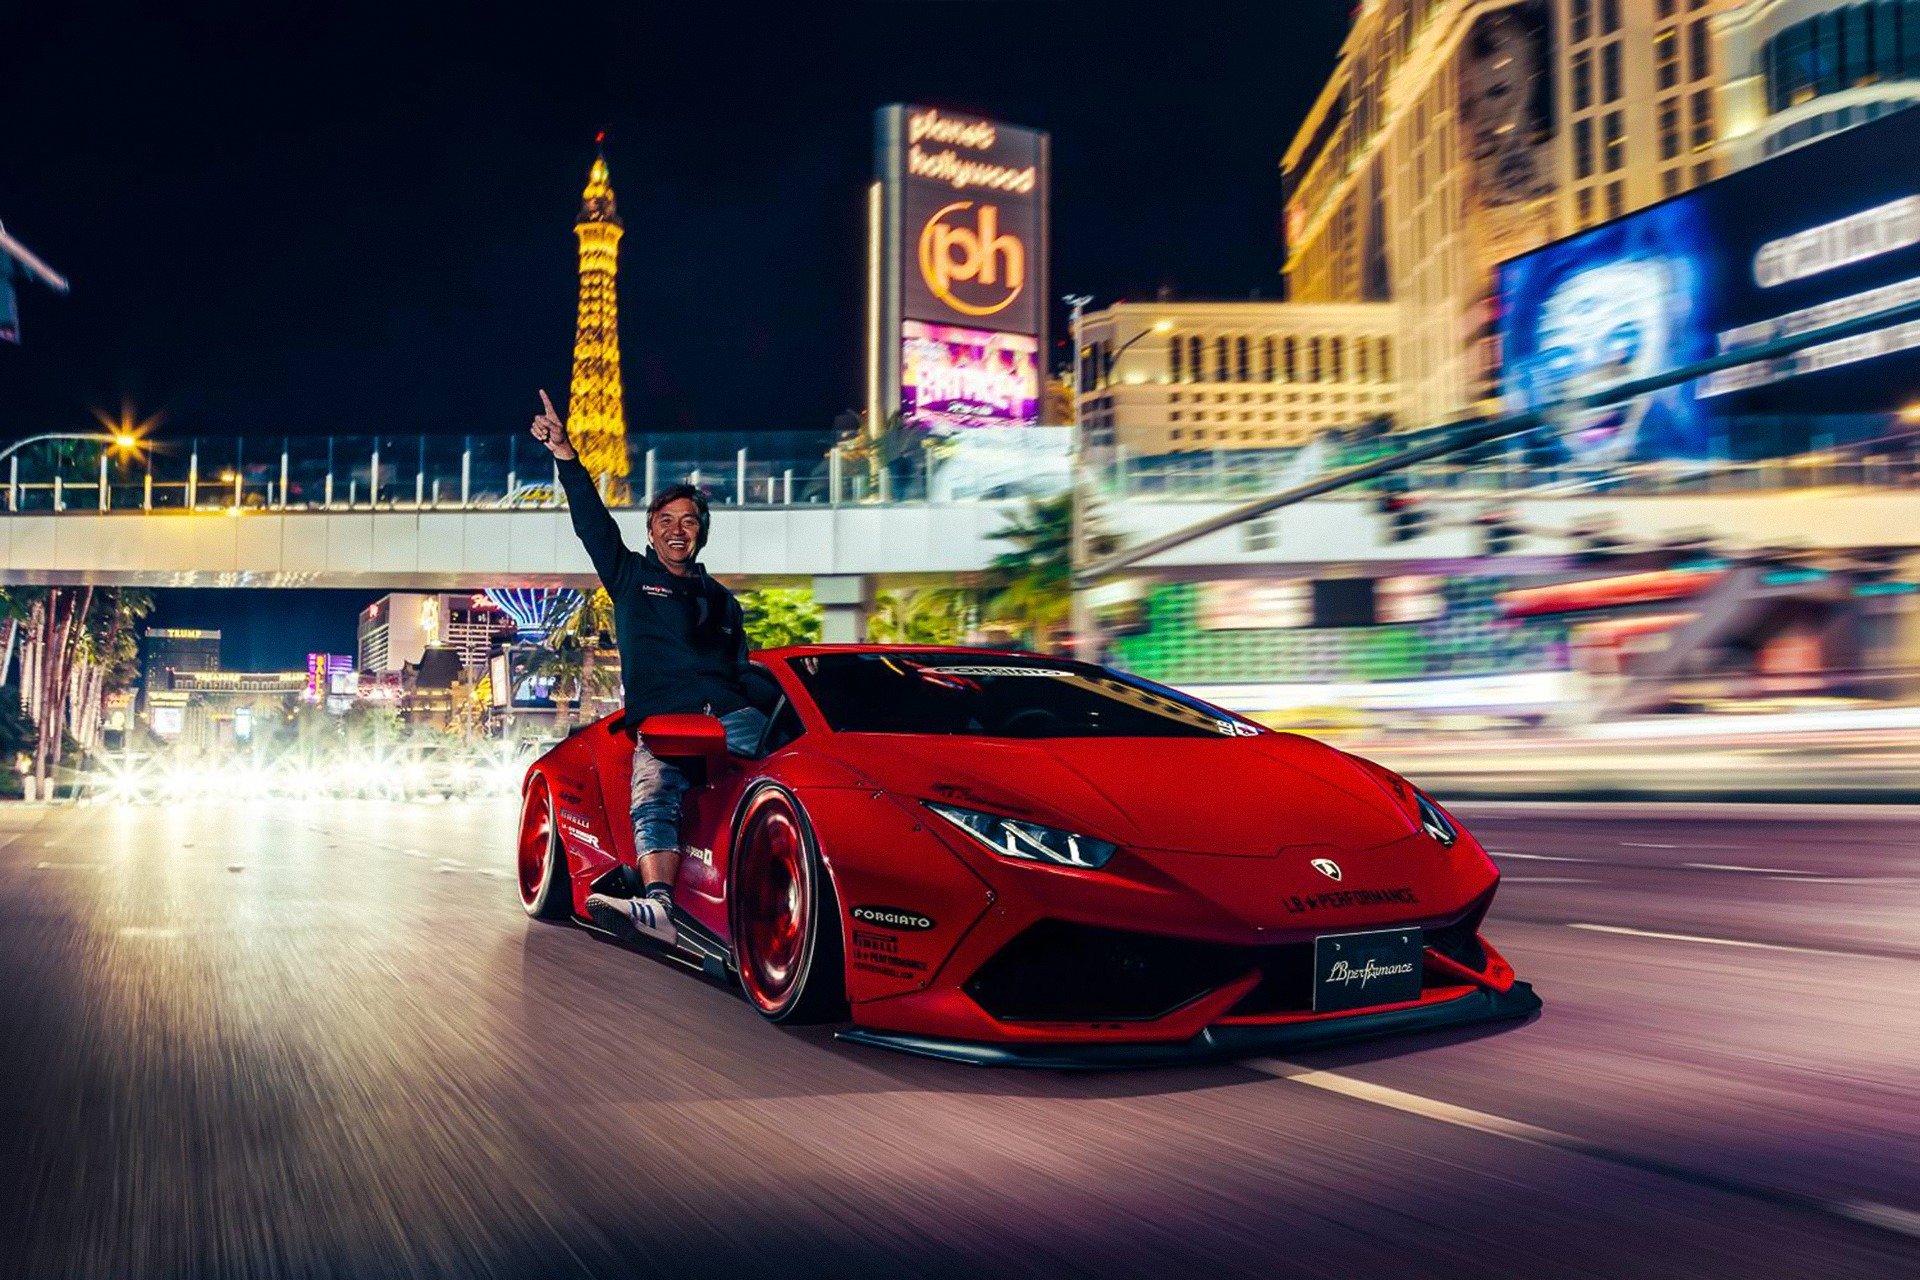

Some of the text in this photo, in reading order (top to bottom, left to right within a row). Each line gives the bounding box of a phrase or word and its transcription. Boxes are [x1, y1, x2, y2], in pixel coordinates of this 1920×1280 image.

[909, 108, 997, 150] planet
[909, 144, 1036, 194] hollywood
[167, 629, 201, 638] TRUMP
[854, 909, 930, 928] FORGIATO
